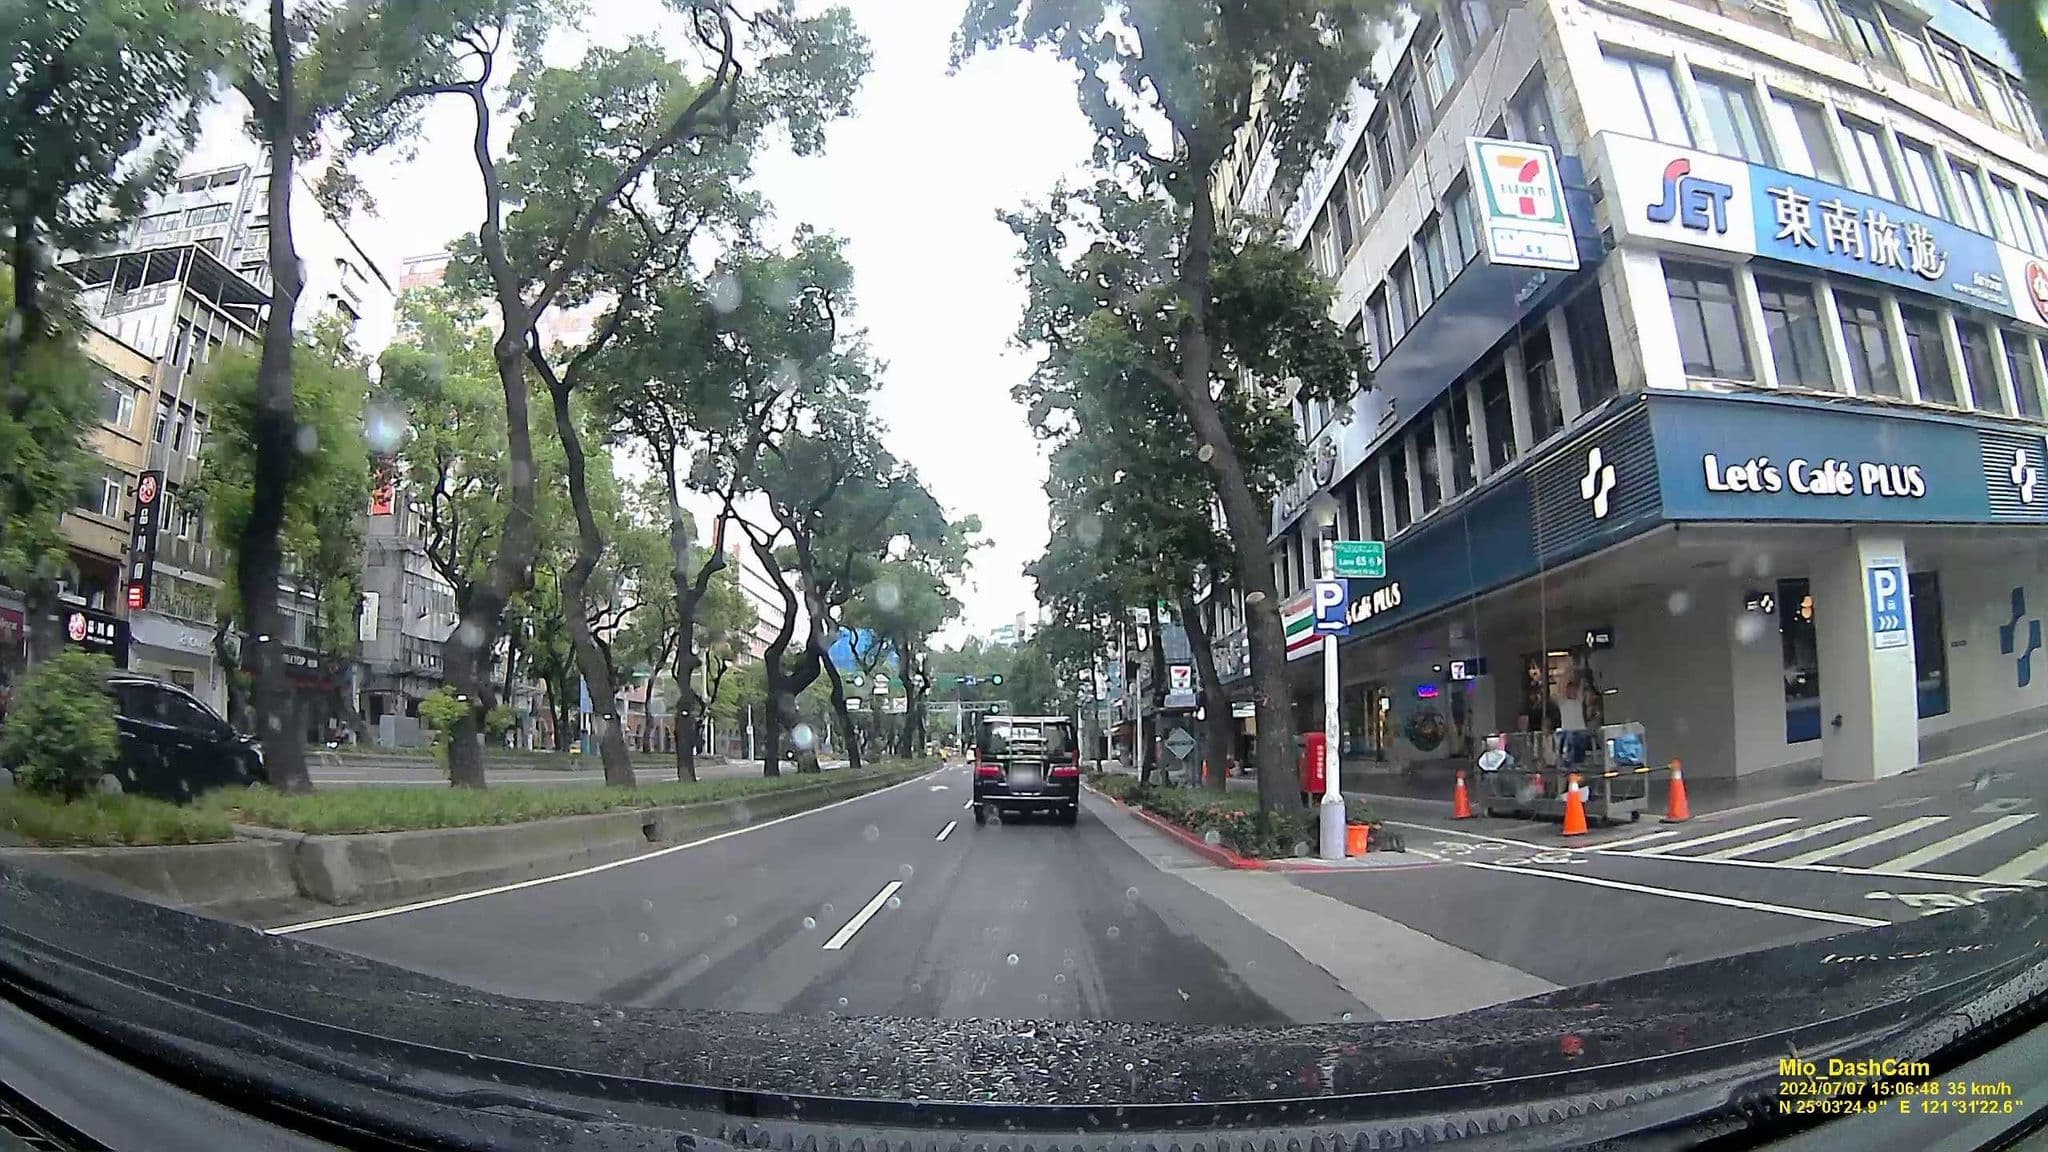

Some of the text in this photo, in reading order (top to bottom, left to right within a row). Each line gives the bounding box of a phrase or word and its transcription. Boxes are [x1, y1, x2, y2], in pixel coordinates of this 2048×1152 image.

[1767, 185, 1948, 281] 東南旅遊
[1704, 454, 1926, 498] Let's Café PLUS
[1315, 582, 1343, 619] P
[1874, 570, 1897, 612] P
